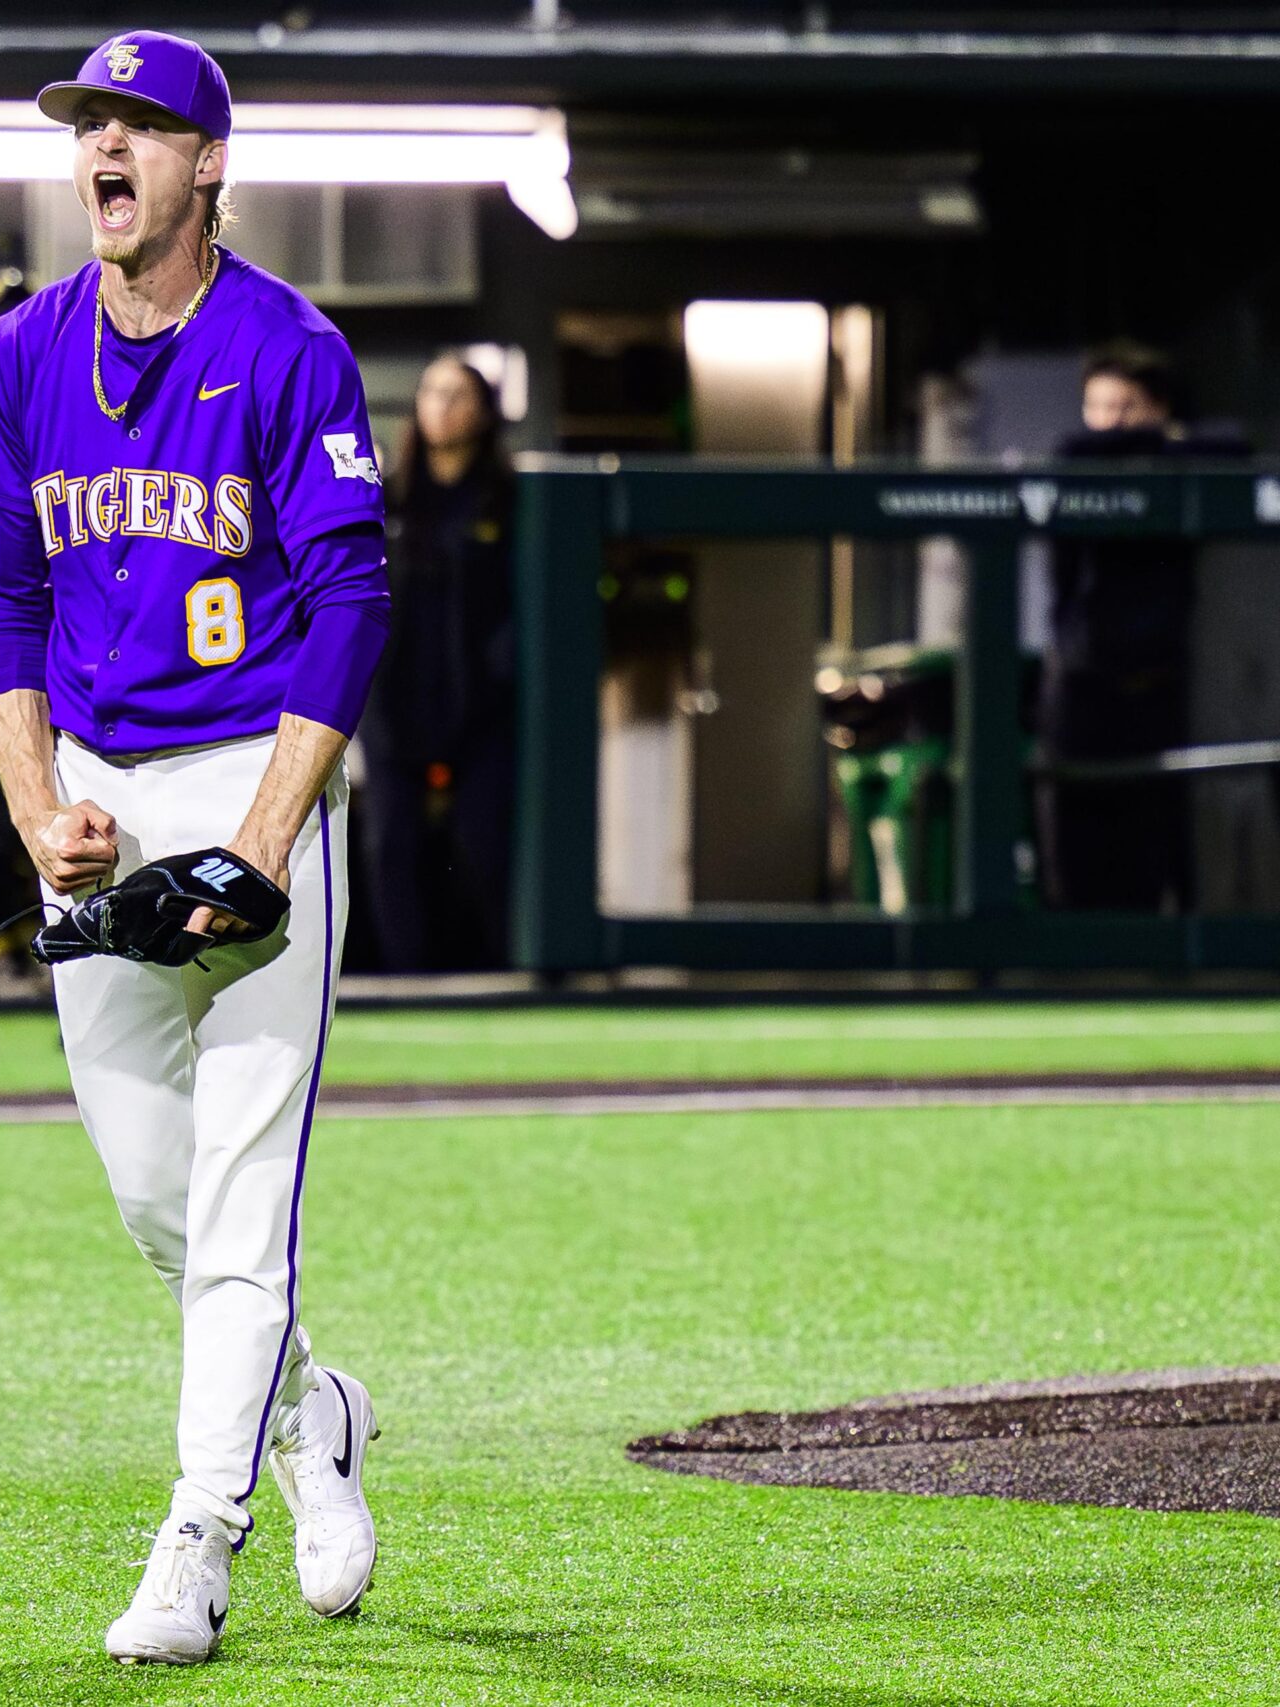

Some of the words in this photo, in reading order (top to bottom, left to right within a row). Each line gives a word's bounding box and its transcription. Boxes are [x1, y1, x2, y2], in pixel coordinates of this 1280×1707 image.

[103, 36, 143, 82] LSU
[31, 467, 253, 558] TIGERS
[185, 577, 246, 667] 8
[184, 1521, 202, 1531] NIKE
